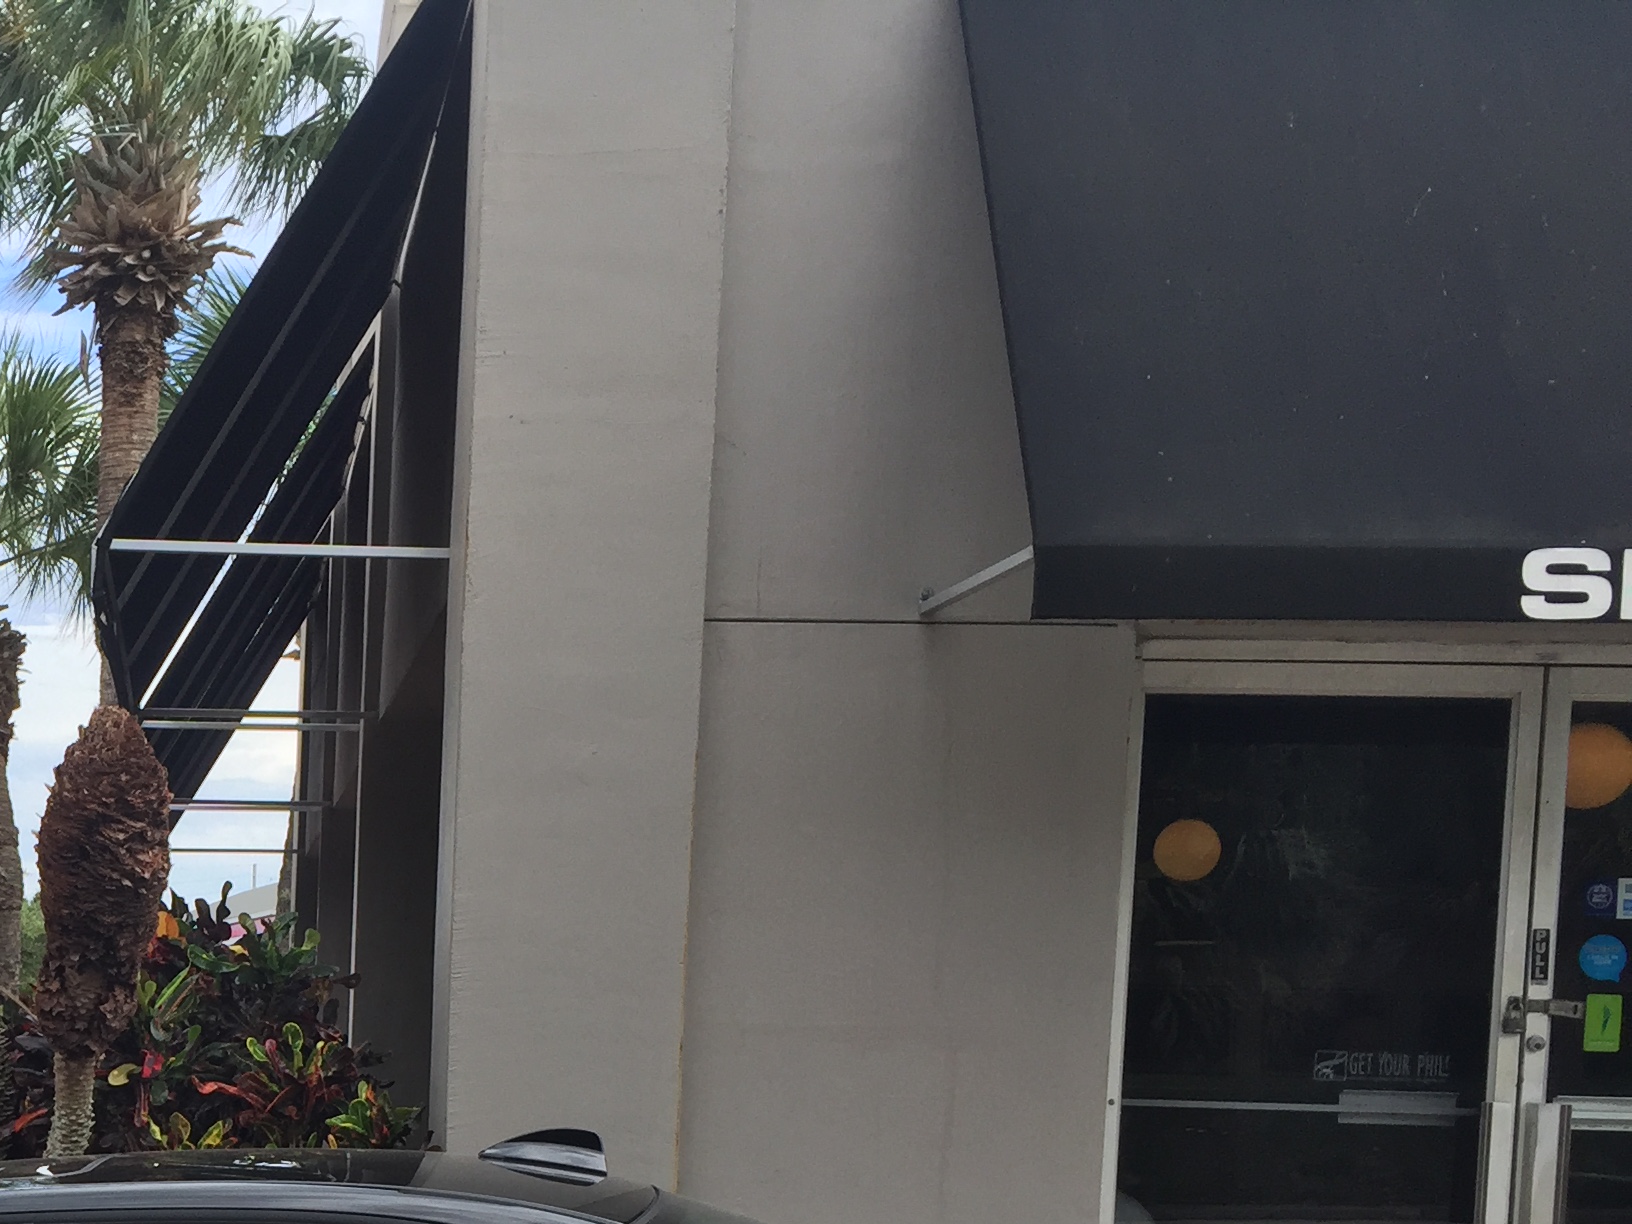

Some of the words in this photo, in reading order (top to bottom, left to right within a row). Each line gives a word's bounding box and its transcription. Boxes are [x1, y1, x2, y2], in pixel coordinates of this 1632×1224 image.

[1520, 547, 1632, 620] S
[1534, 929, 1547, 979] PULL
[1349, 1052, 1374, 1075] GET
[1378, 1052, 1410, 1076] YOUR
